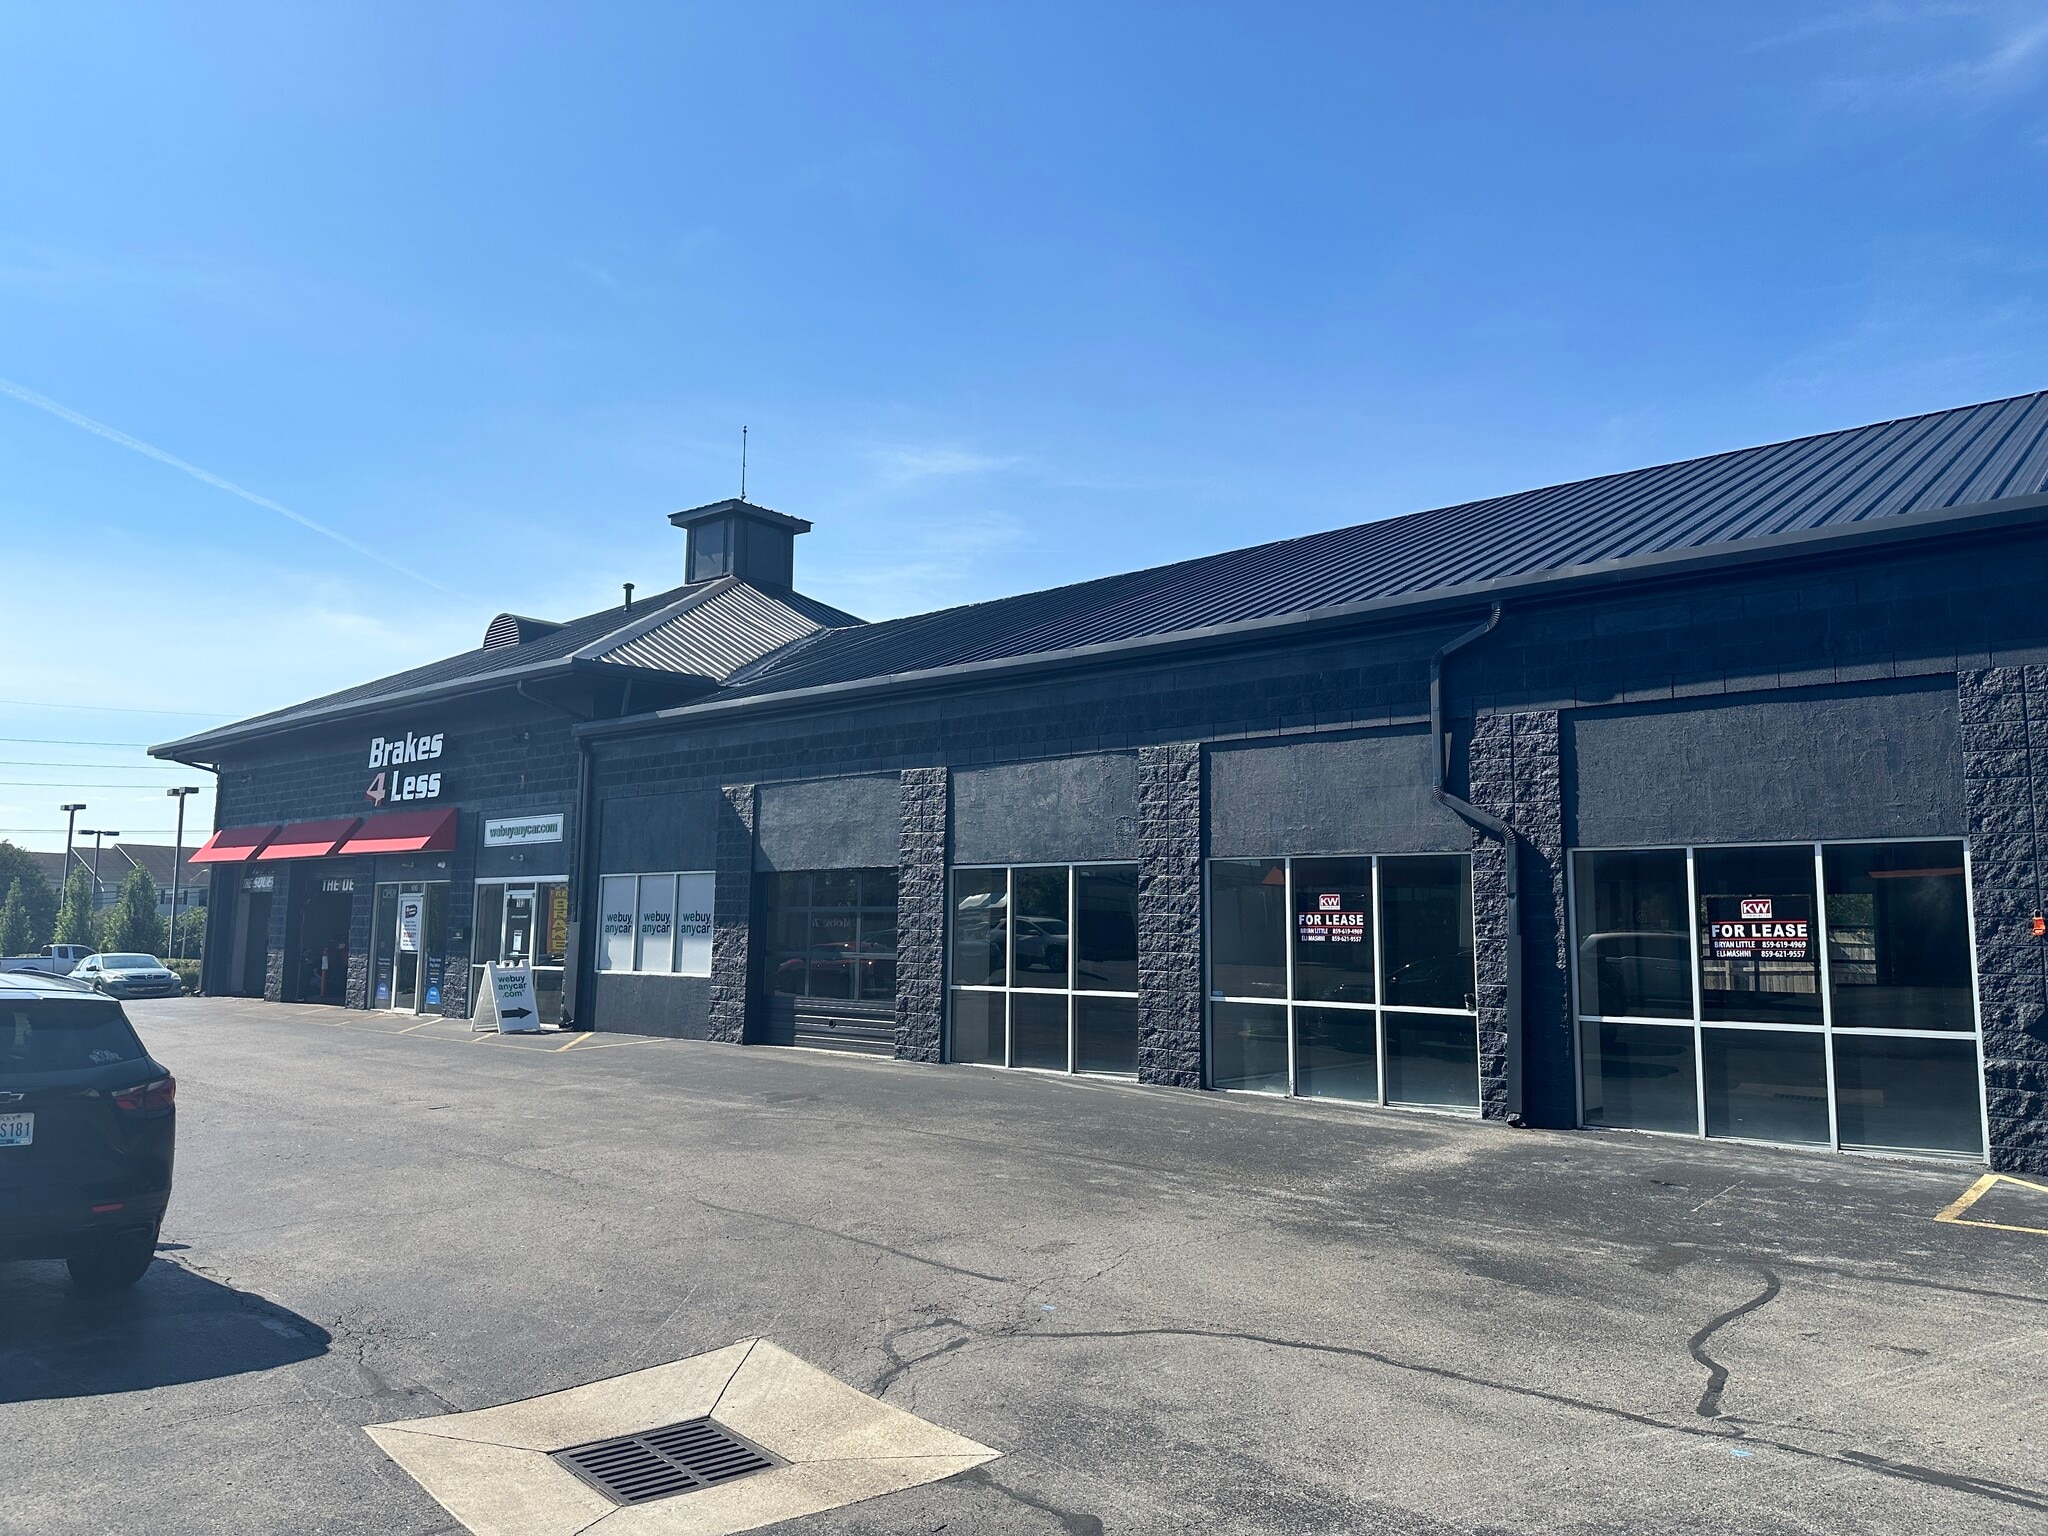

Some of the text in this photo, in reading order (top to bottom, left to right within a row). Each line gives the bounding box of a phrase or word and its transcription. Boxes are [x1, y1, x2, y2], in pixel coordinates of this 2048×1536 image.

[368, 731, 444, 769] Brakes
[366, 770, 442, 807] 4 Less
[489, 823, 558, 839] webuyanycar.com
[1320, 897, 1339, 906] KW
[1743, 903, 1770, 914] KW
[607, 911, 633, 925] webuy
[643, 910, 671, 924] webuy
[683, 910, 712, 925] webuy
[1298, 914, 1364, 926] FOR LEASE
[605, 923, 632, 936] anycar
[641, 923, 671, 936] anycar
[681, 923, 711, 936] anycar
[1711, 924, 1808, 938] FOR LEASE
[1760, 950, 1806, 958] 859-621-9557
[497, 974, 526, 983] webuy
[497, 982, 528, 992] anycar
[502, 990, 523, 998] .com
[0, 1122, 30, 1138] S181
